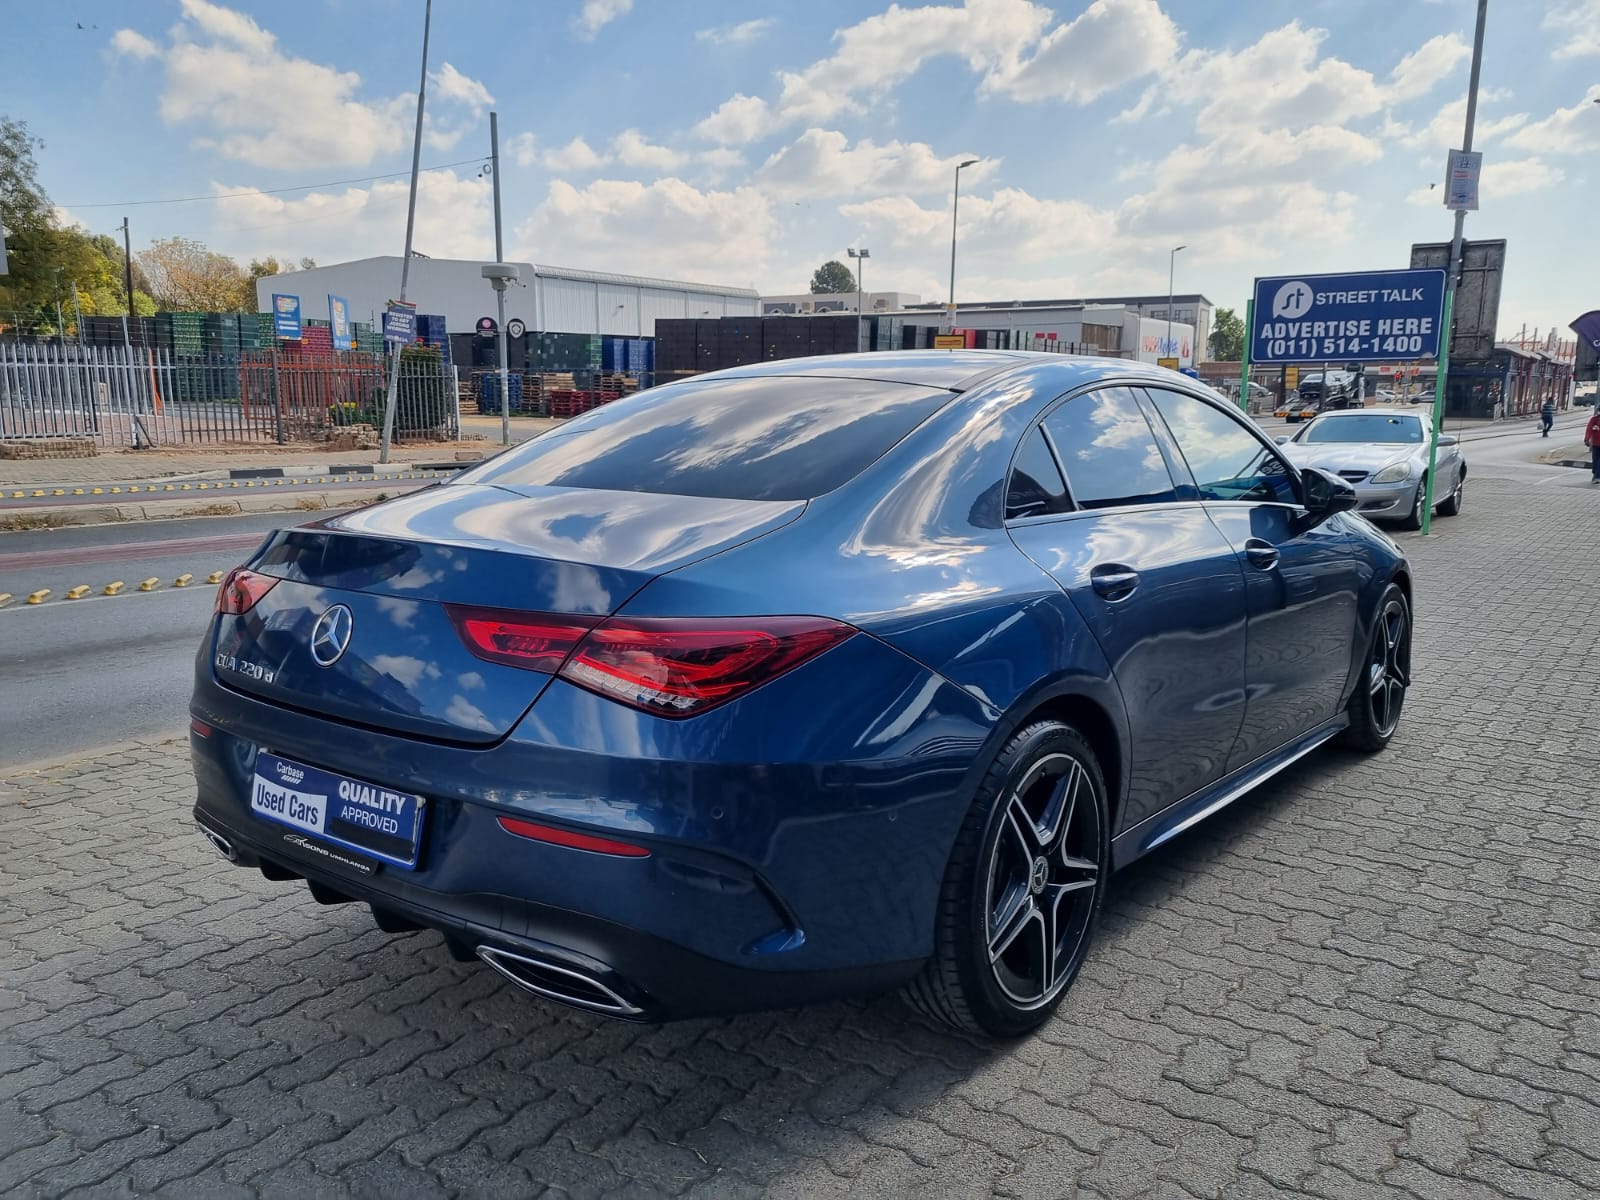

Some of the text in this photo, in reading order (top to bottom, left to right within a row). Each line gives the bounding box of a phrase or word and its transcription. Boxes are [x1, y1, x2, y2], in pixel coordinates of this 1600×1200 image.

[1316, 291, 1378, 305] STREET
[1381, 288, 1424, 302] TALK
[1260, 317, 1432, 339] ADVERTISE HERE
[1267, 336, 1422, 359] (011) 514-1400
[239, 660, 264, 679] 220
[264, 672, 274, 684] d
[277, 762, 304, 779] Carbase
[256, 783, 319, 826] Used Cars
[338, 780, 407, 815] QUALITY
[341, 805, 399, 834] APPROVED
